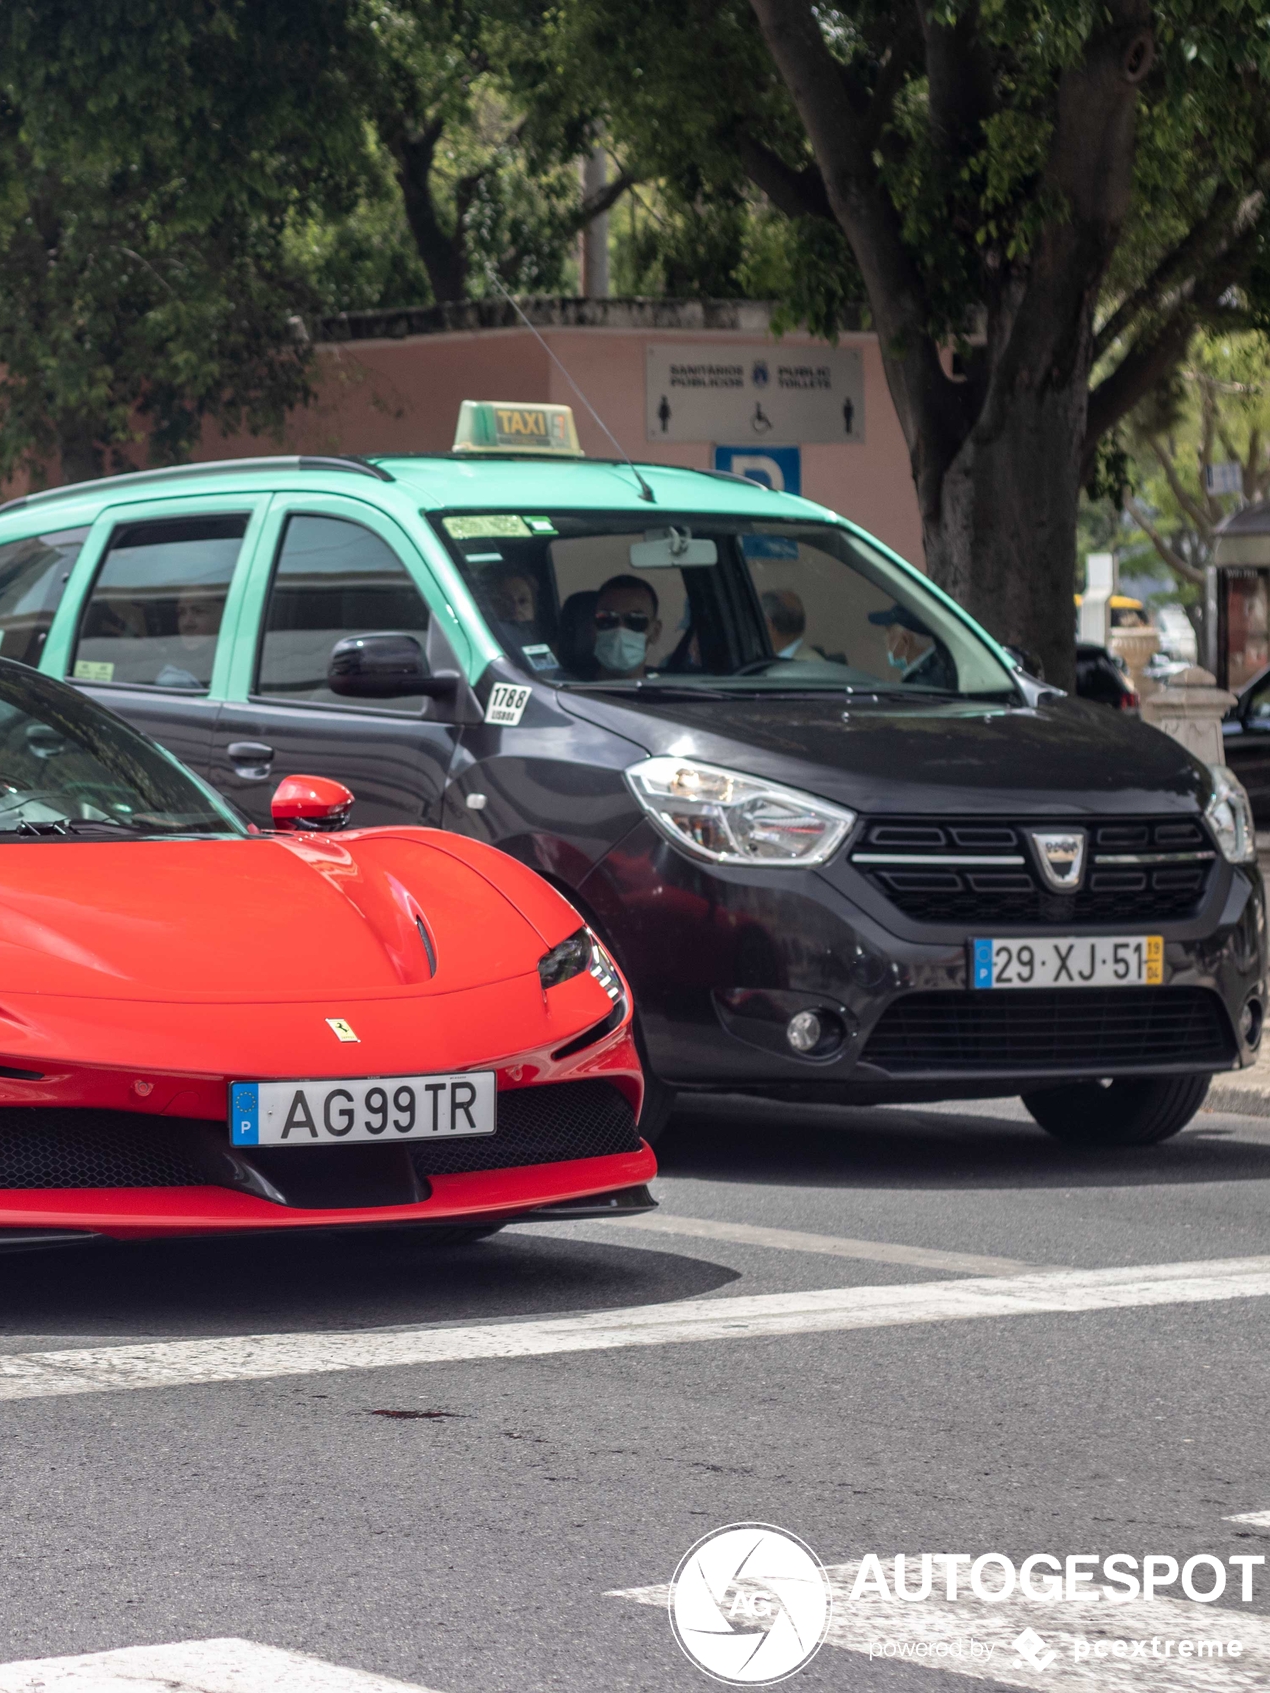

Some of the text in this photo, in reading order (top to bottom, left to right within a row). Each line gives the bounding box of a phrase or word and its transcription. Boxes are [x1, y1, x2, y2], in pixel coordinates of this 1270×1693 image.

[778, 365, 830, 377] PUBLIC
[497, 411, 546, 435] TAXI
[493, 687, 527, 708] 1788
[241, 1121, 251, 1134] P
